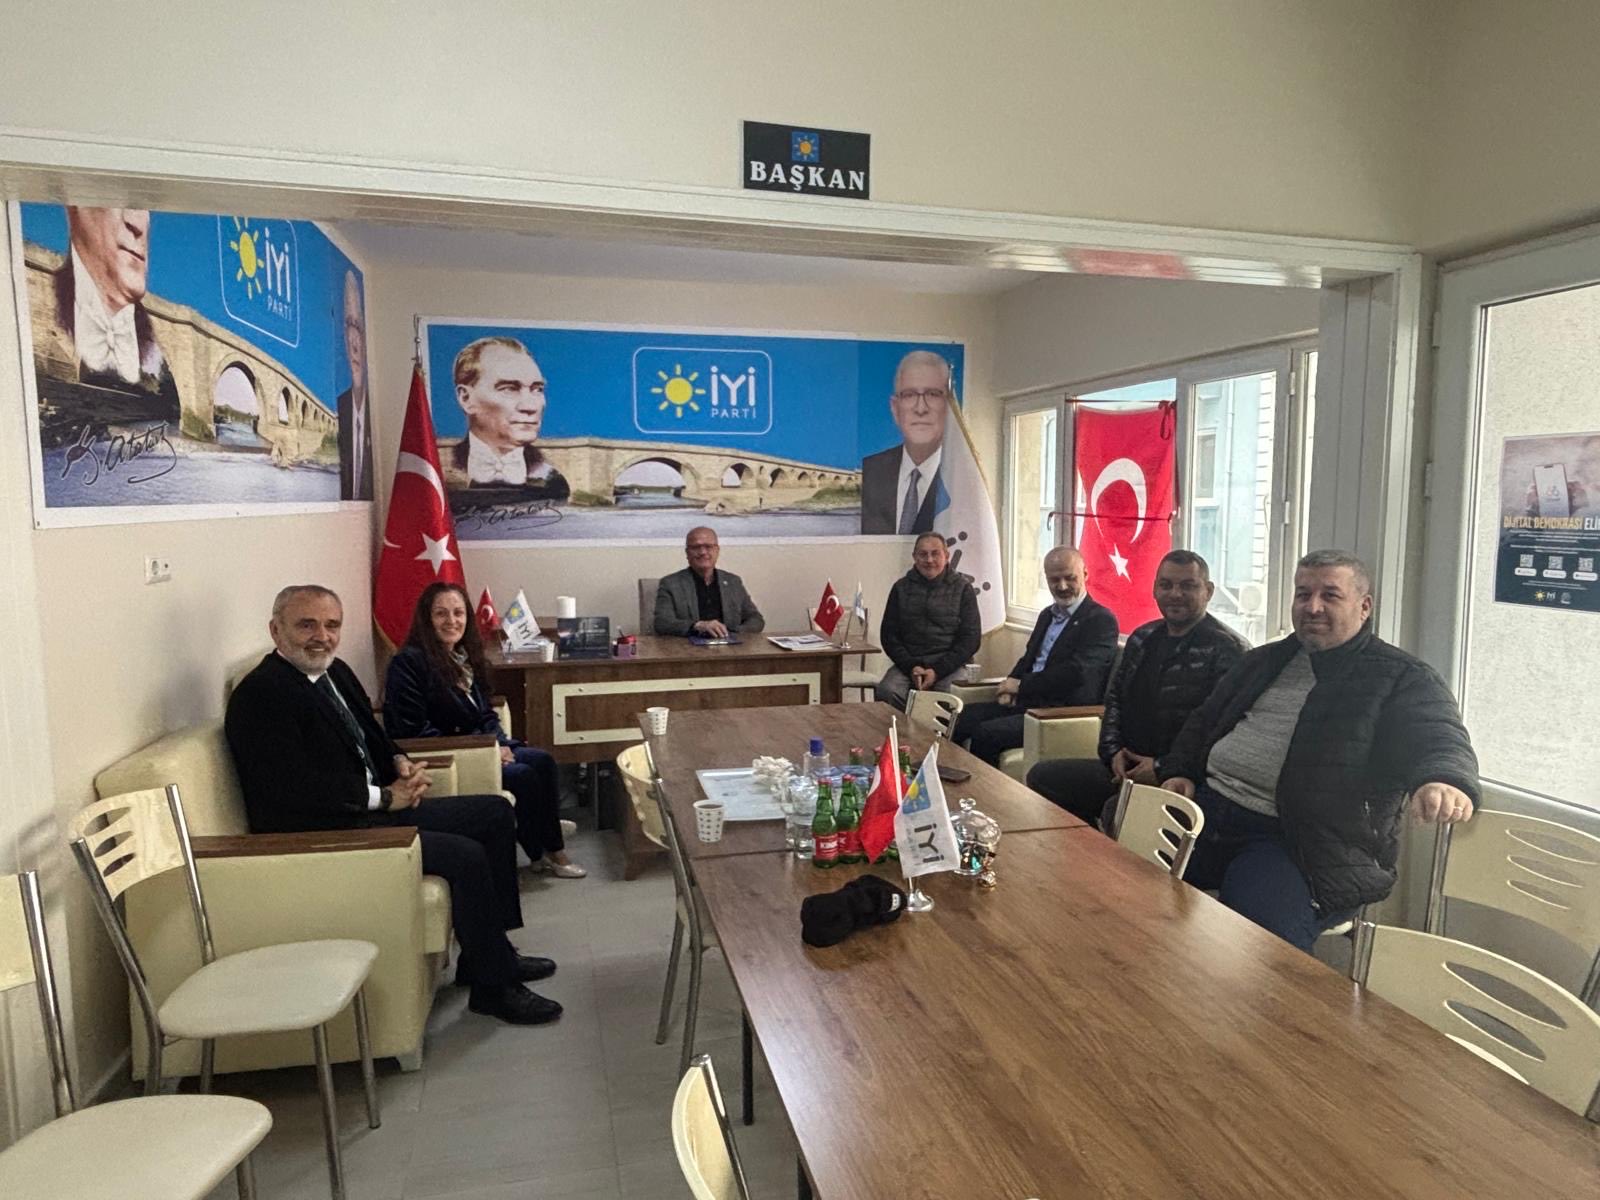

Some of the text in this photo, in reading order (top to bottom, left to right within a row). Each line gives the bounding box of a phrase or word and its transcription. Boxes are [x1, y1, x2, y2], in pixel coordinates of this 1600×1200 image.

[750, 160, 865, 192] BAŞKAN
[265, 226, 291, 303] İYİ
[710, 365, 756, 407] İYİ
[914, 823, 945, 863] İYİ
